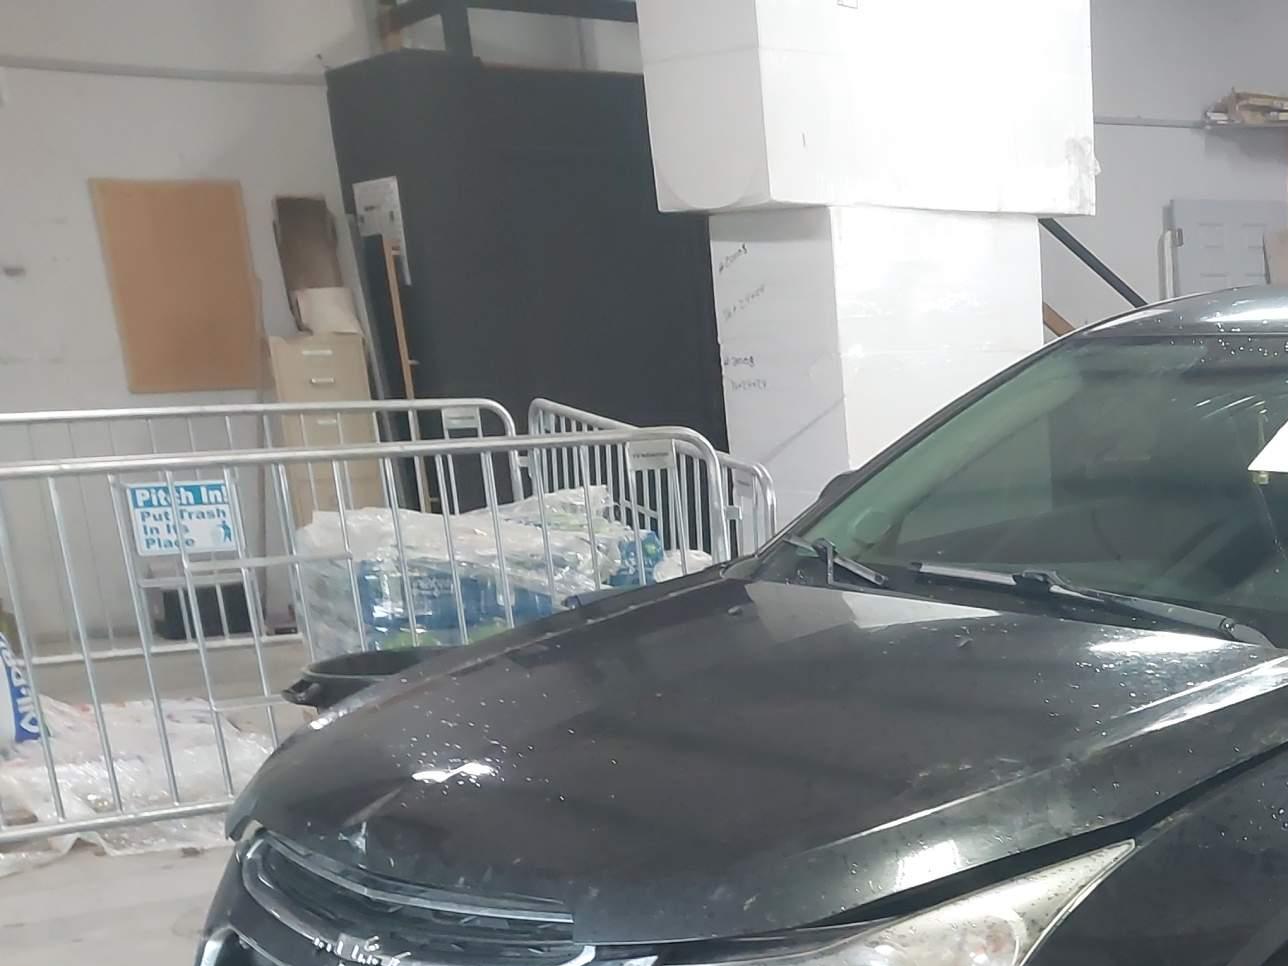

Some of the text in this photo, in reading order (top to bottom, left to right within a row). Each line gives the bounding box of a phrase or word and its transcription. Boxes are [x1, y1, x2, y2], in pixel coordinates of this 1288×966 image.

[141, 508, 226, 521] Put Trash
[143, 524, 160, 535] In
